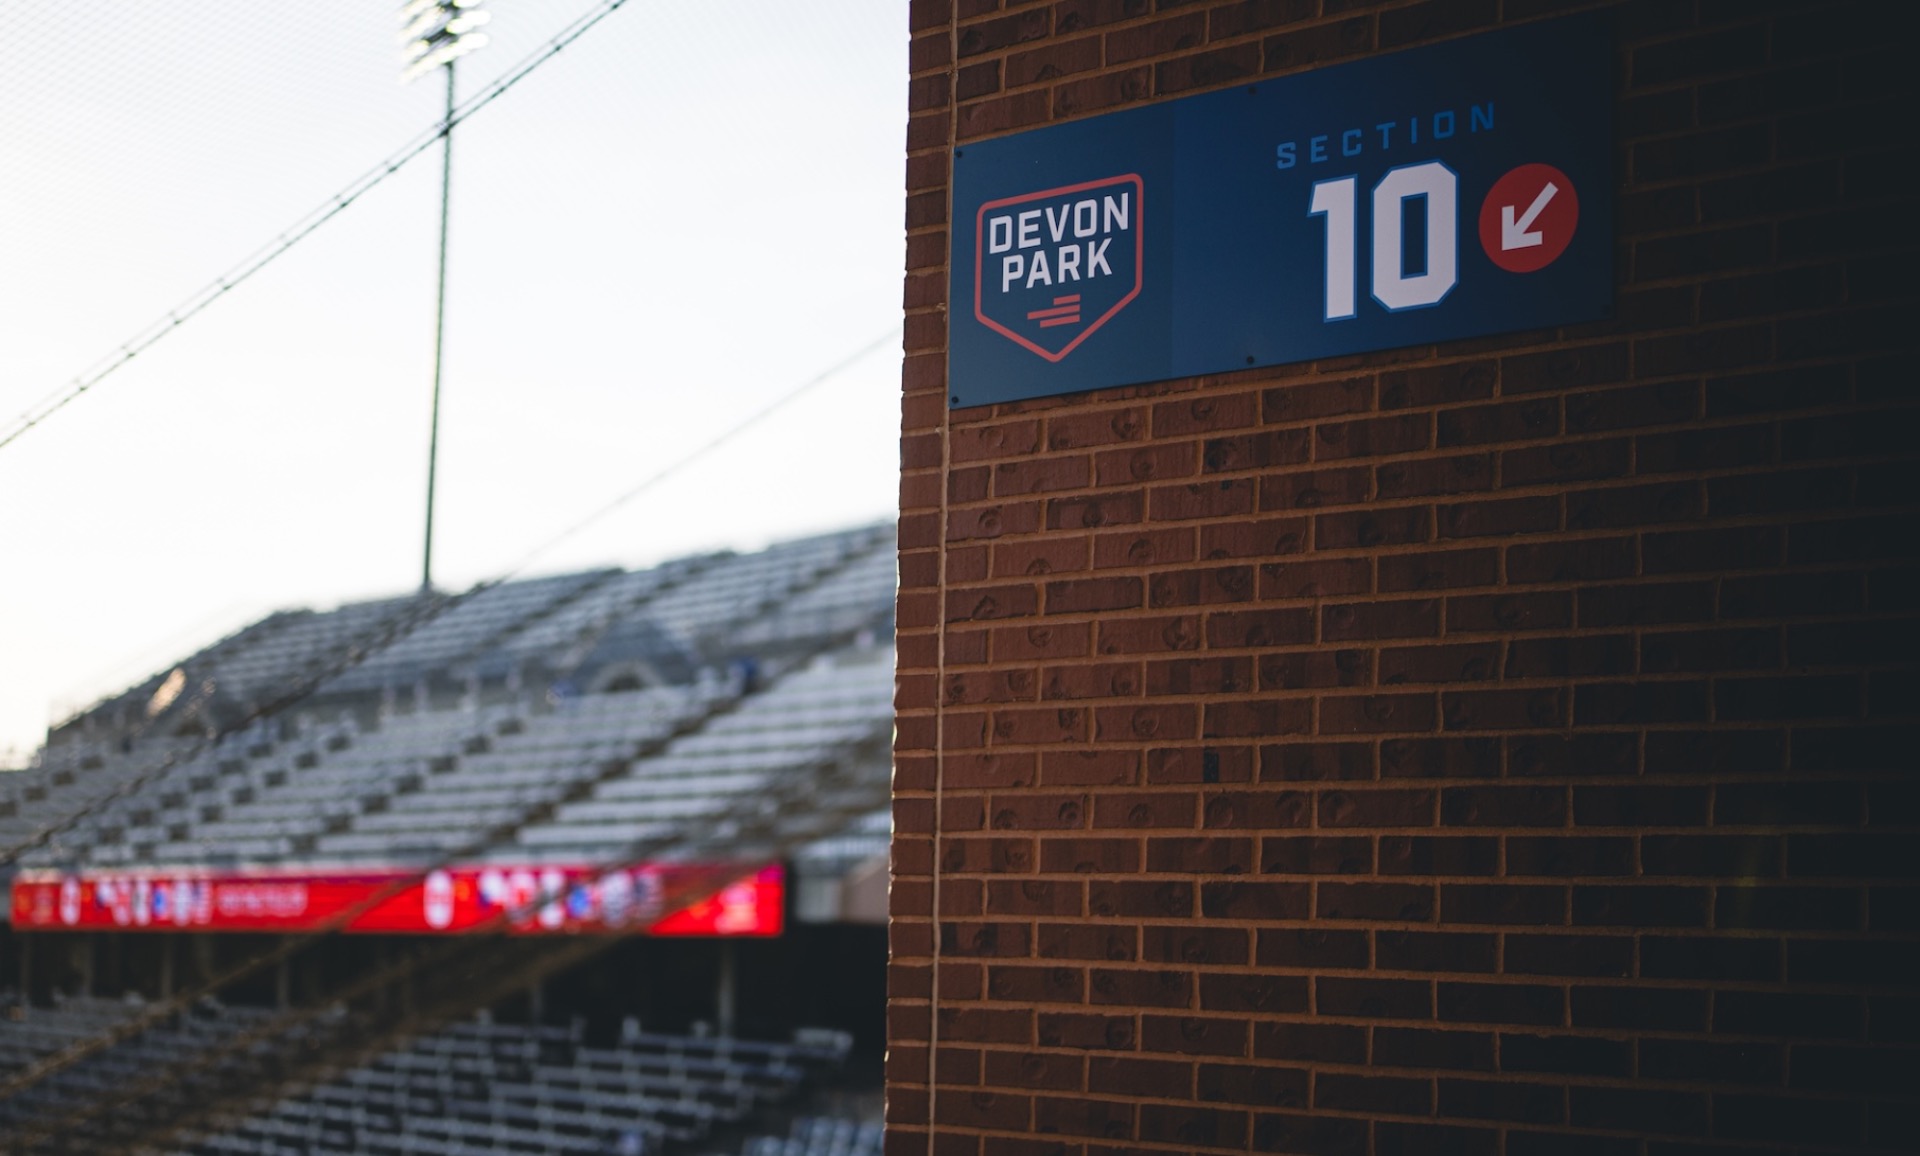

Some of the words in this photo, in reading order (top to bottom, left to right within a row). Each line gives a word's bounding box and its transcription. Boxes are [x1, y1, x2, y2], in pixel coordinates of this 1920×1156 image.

[1276, 104, 1495, 169] SECTION
[989, 192, 1129, 254] DEVON
[1308, 160, 1459, 322] 10
[1002, 237, 1113, 292] PARK
